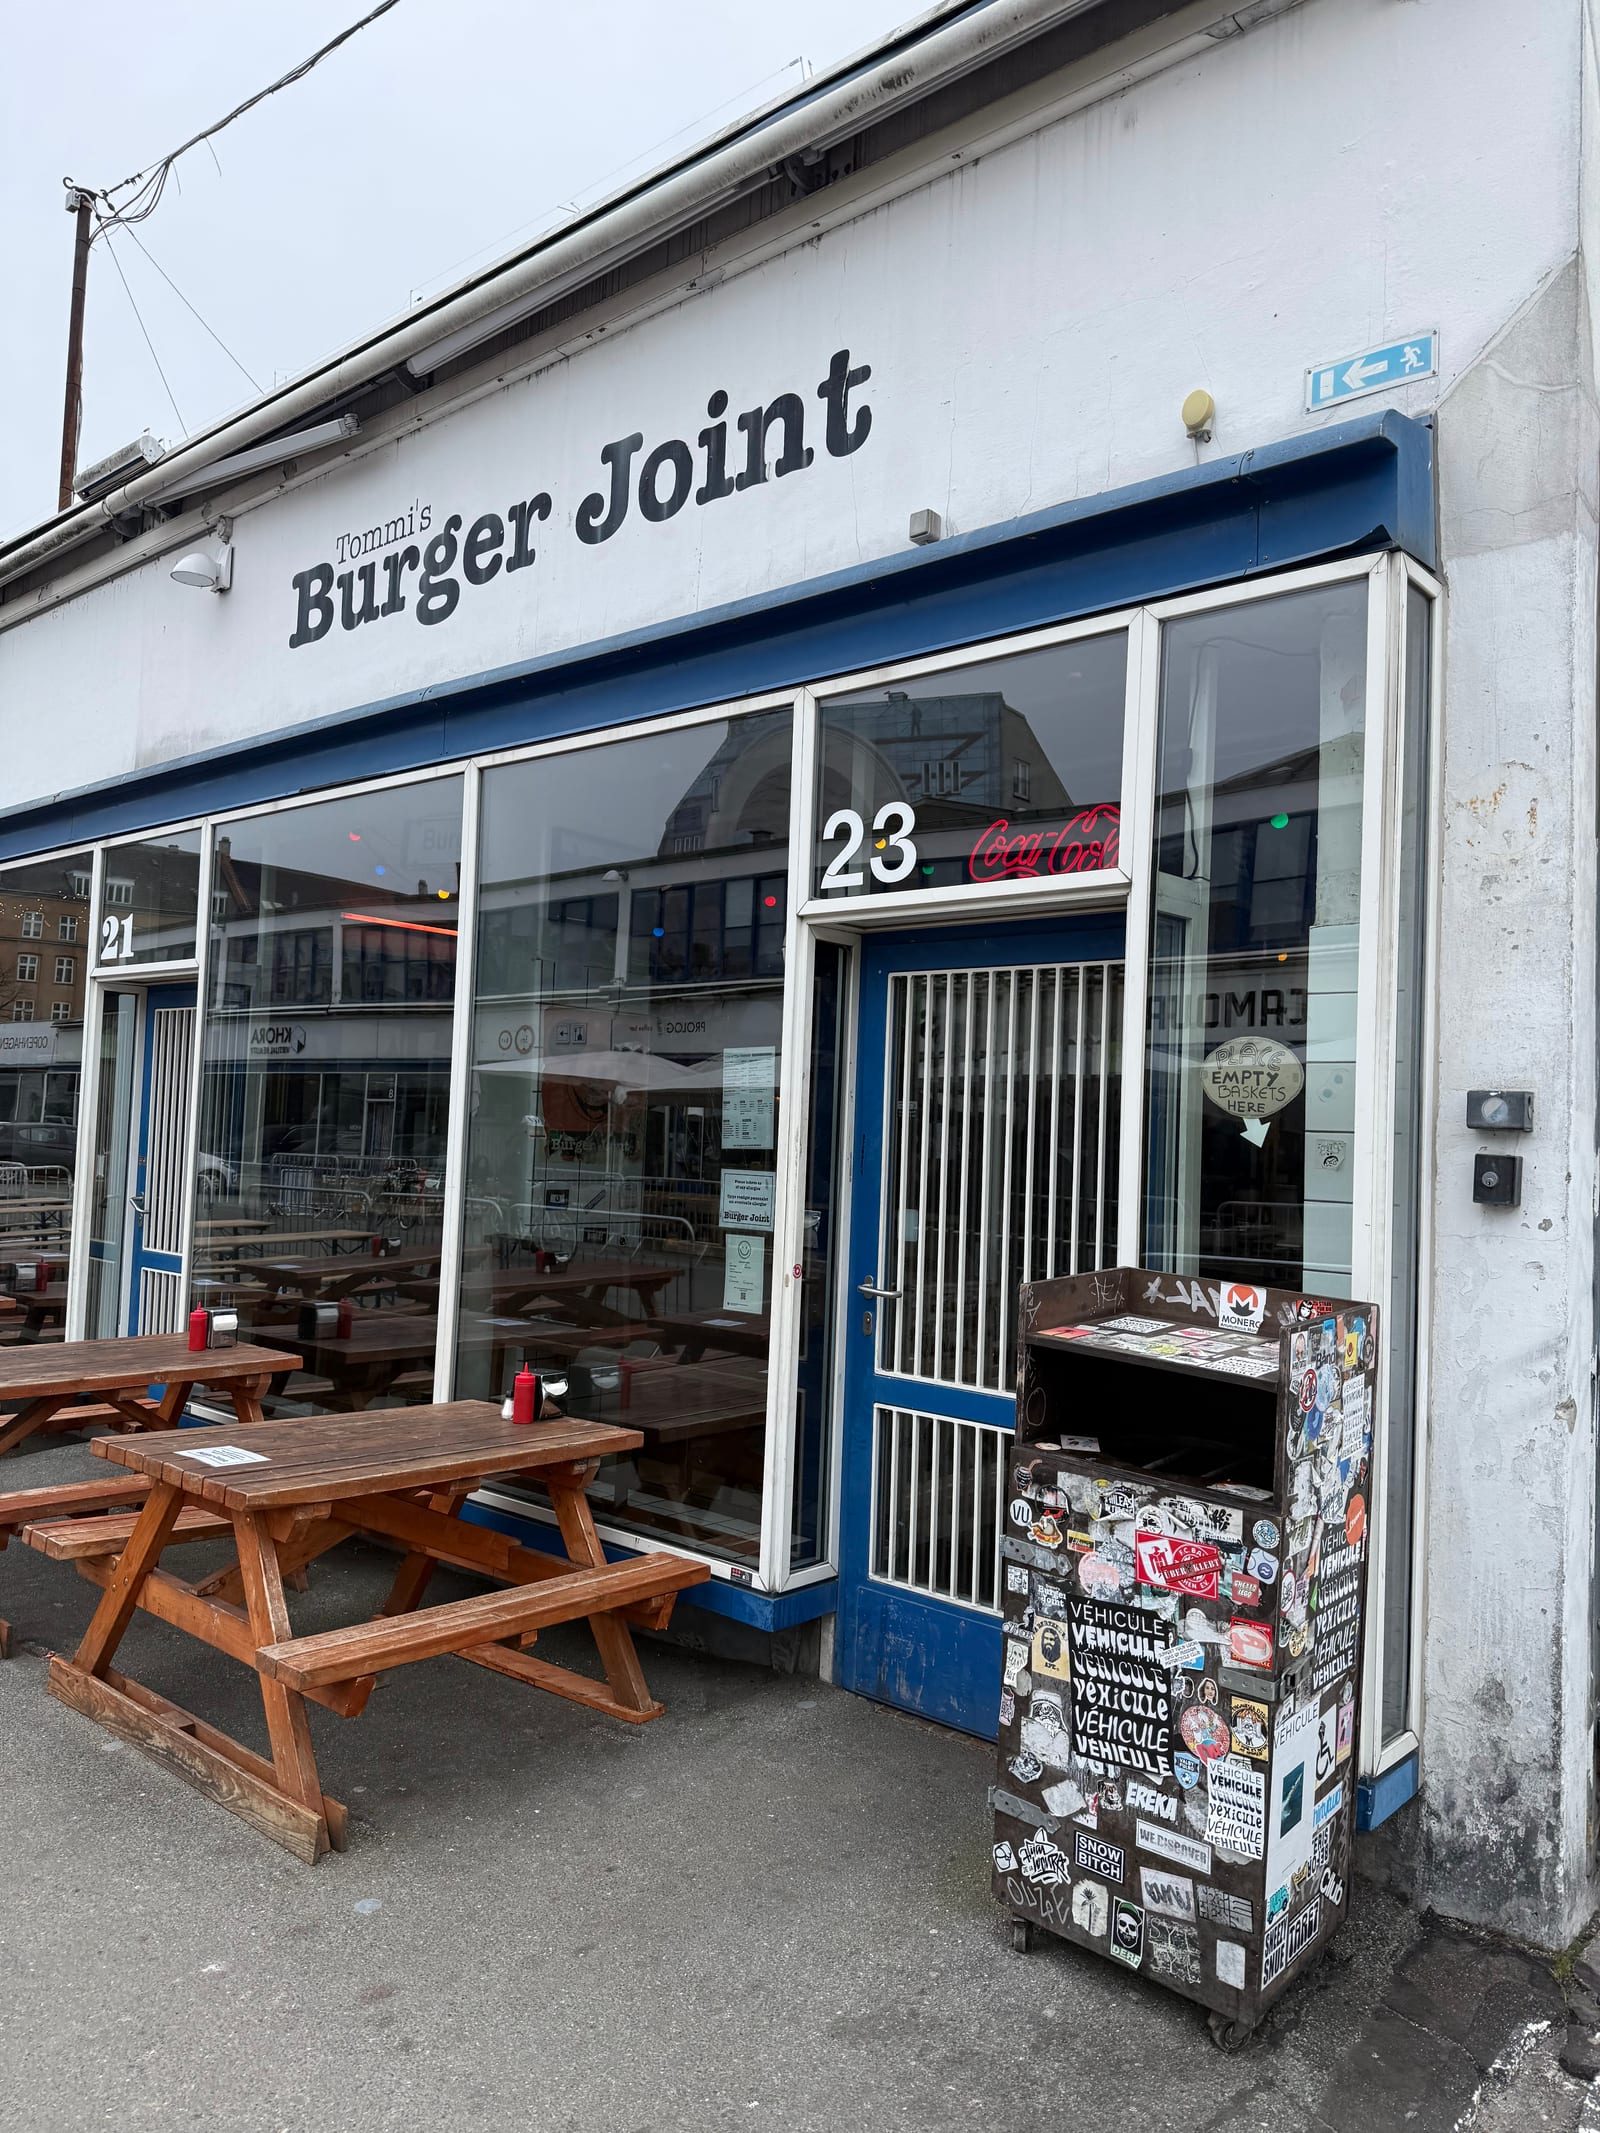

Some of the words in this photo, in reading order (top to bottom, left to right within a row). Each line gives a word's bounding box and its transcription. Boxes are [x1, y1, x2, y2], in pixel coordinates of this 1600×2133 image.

[289, 492, 551, 649] Burger
[575, 349, 872, 544] Joint
[336, 499, 432, 564] Tommi's
[820, 801, 917, 890] 23
[101, 913, 134, 960] 21
[1215, 1042, 1285, 1071] PLACE
[1211, 1070, 1279, 1087] EMPTY
[1217, 1085, 1286, 1102] BASKETS
[1227, 1100, 1265, 1114] HERE
[724, 1211, 749, 1222] Burger
[749, 1213, 770, 1223] Joint
[1221, 1314, 1261, 1328] MONERO
[1012, 1503, 1030, 1523] VU
[1321, 1529, 1347, 1554] VÉHIC
[1070, 1600, 1166, 1636] VÉHICULE
[1075, 1704, 1170, 1752] VÉHICULE
[1126, 1781, 1178, 1821] EREKA
[1139, 1828, 1156, 1843] WE
[1078, 1836, 1121, 1862] SNOW
[1078, 1852, 1121, 1879] BITCH
[1112, 1945, 1141, 1968] DERF
